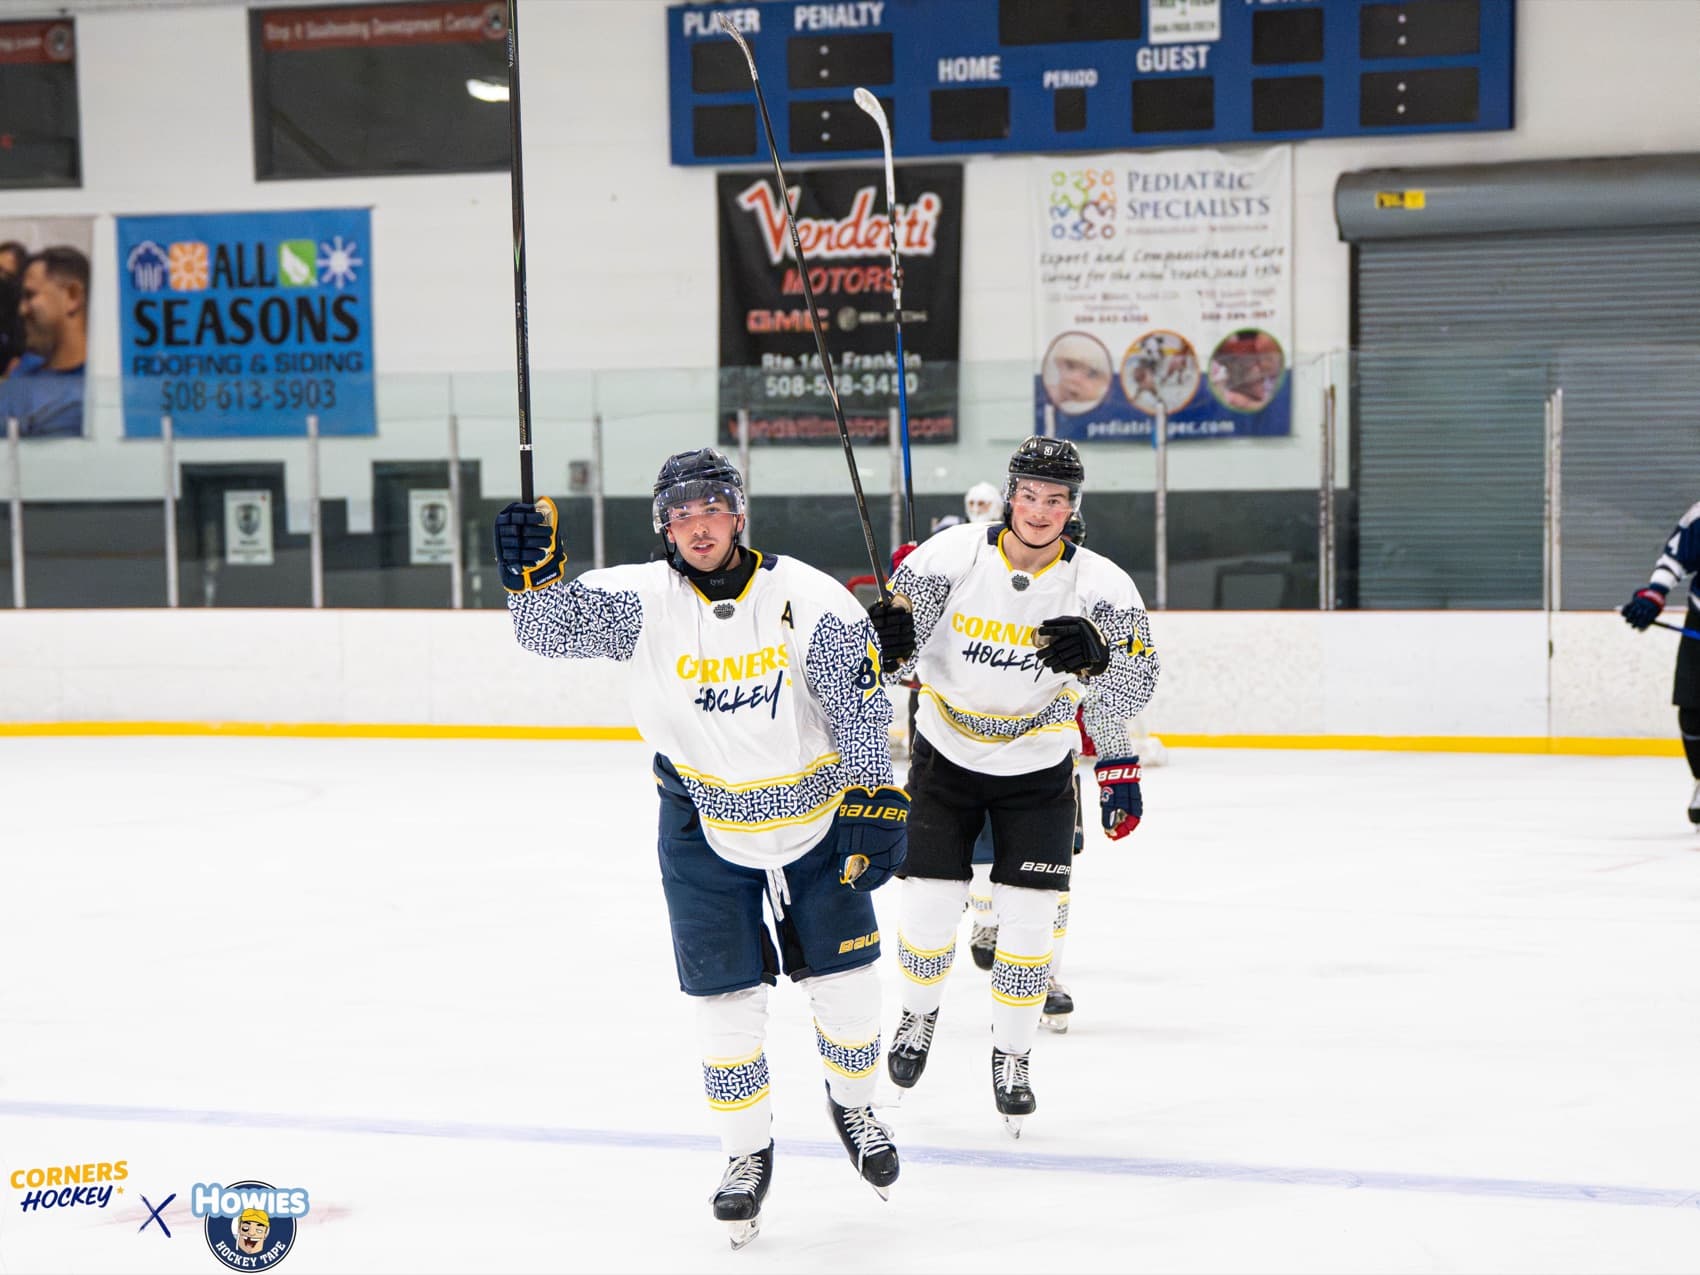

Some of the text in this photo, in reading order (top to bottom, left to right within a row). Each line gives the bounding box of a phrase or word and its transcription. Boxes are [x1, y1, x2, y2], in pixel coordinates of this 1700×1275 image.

[794, 2, 884, 30] PENALTY
[938, 55, 1001, 83] HOME
[1136, 45, 1211, 72] GUEST
[1043, 68, 1098, 90] PERIOD
[1127, 170, 1254, 194] PEDIATRIC
[1127, 197, 1272, 221] SPECIALISTS
[211, 241, 278, 288] ALL
[134, 296, 360, 347] SEASONS
[133, 351, 364, 376] ROOFING & SIDING
[842, 351, 922, 370] Frankin
[161, 379, 337, 412] 508-613-5903
[781, 600, 794, 629] A
[951, 611, 1034, 647] CORNE
[840, 804, 908, 823] BAUER
[1020, 861, 1071, 875] BAUER
